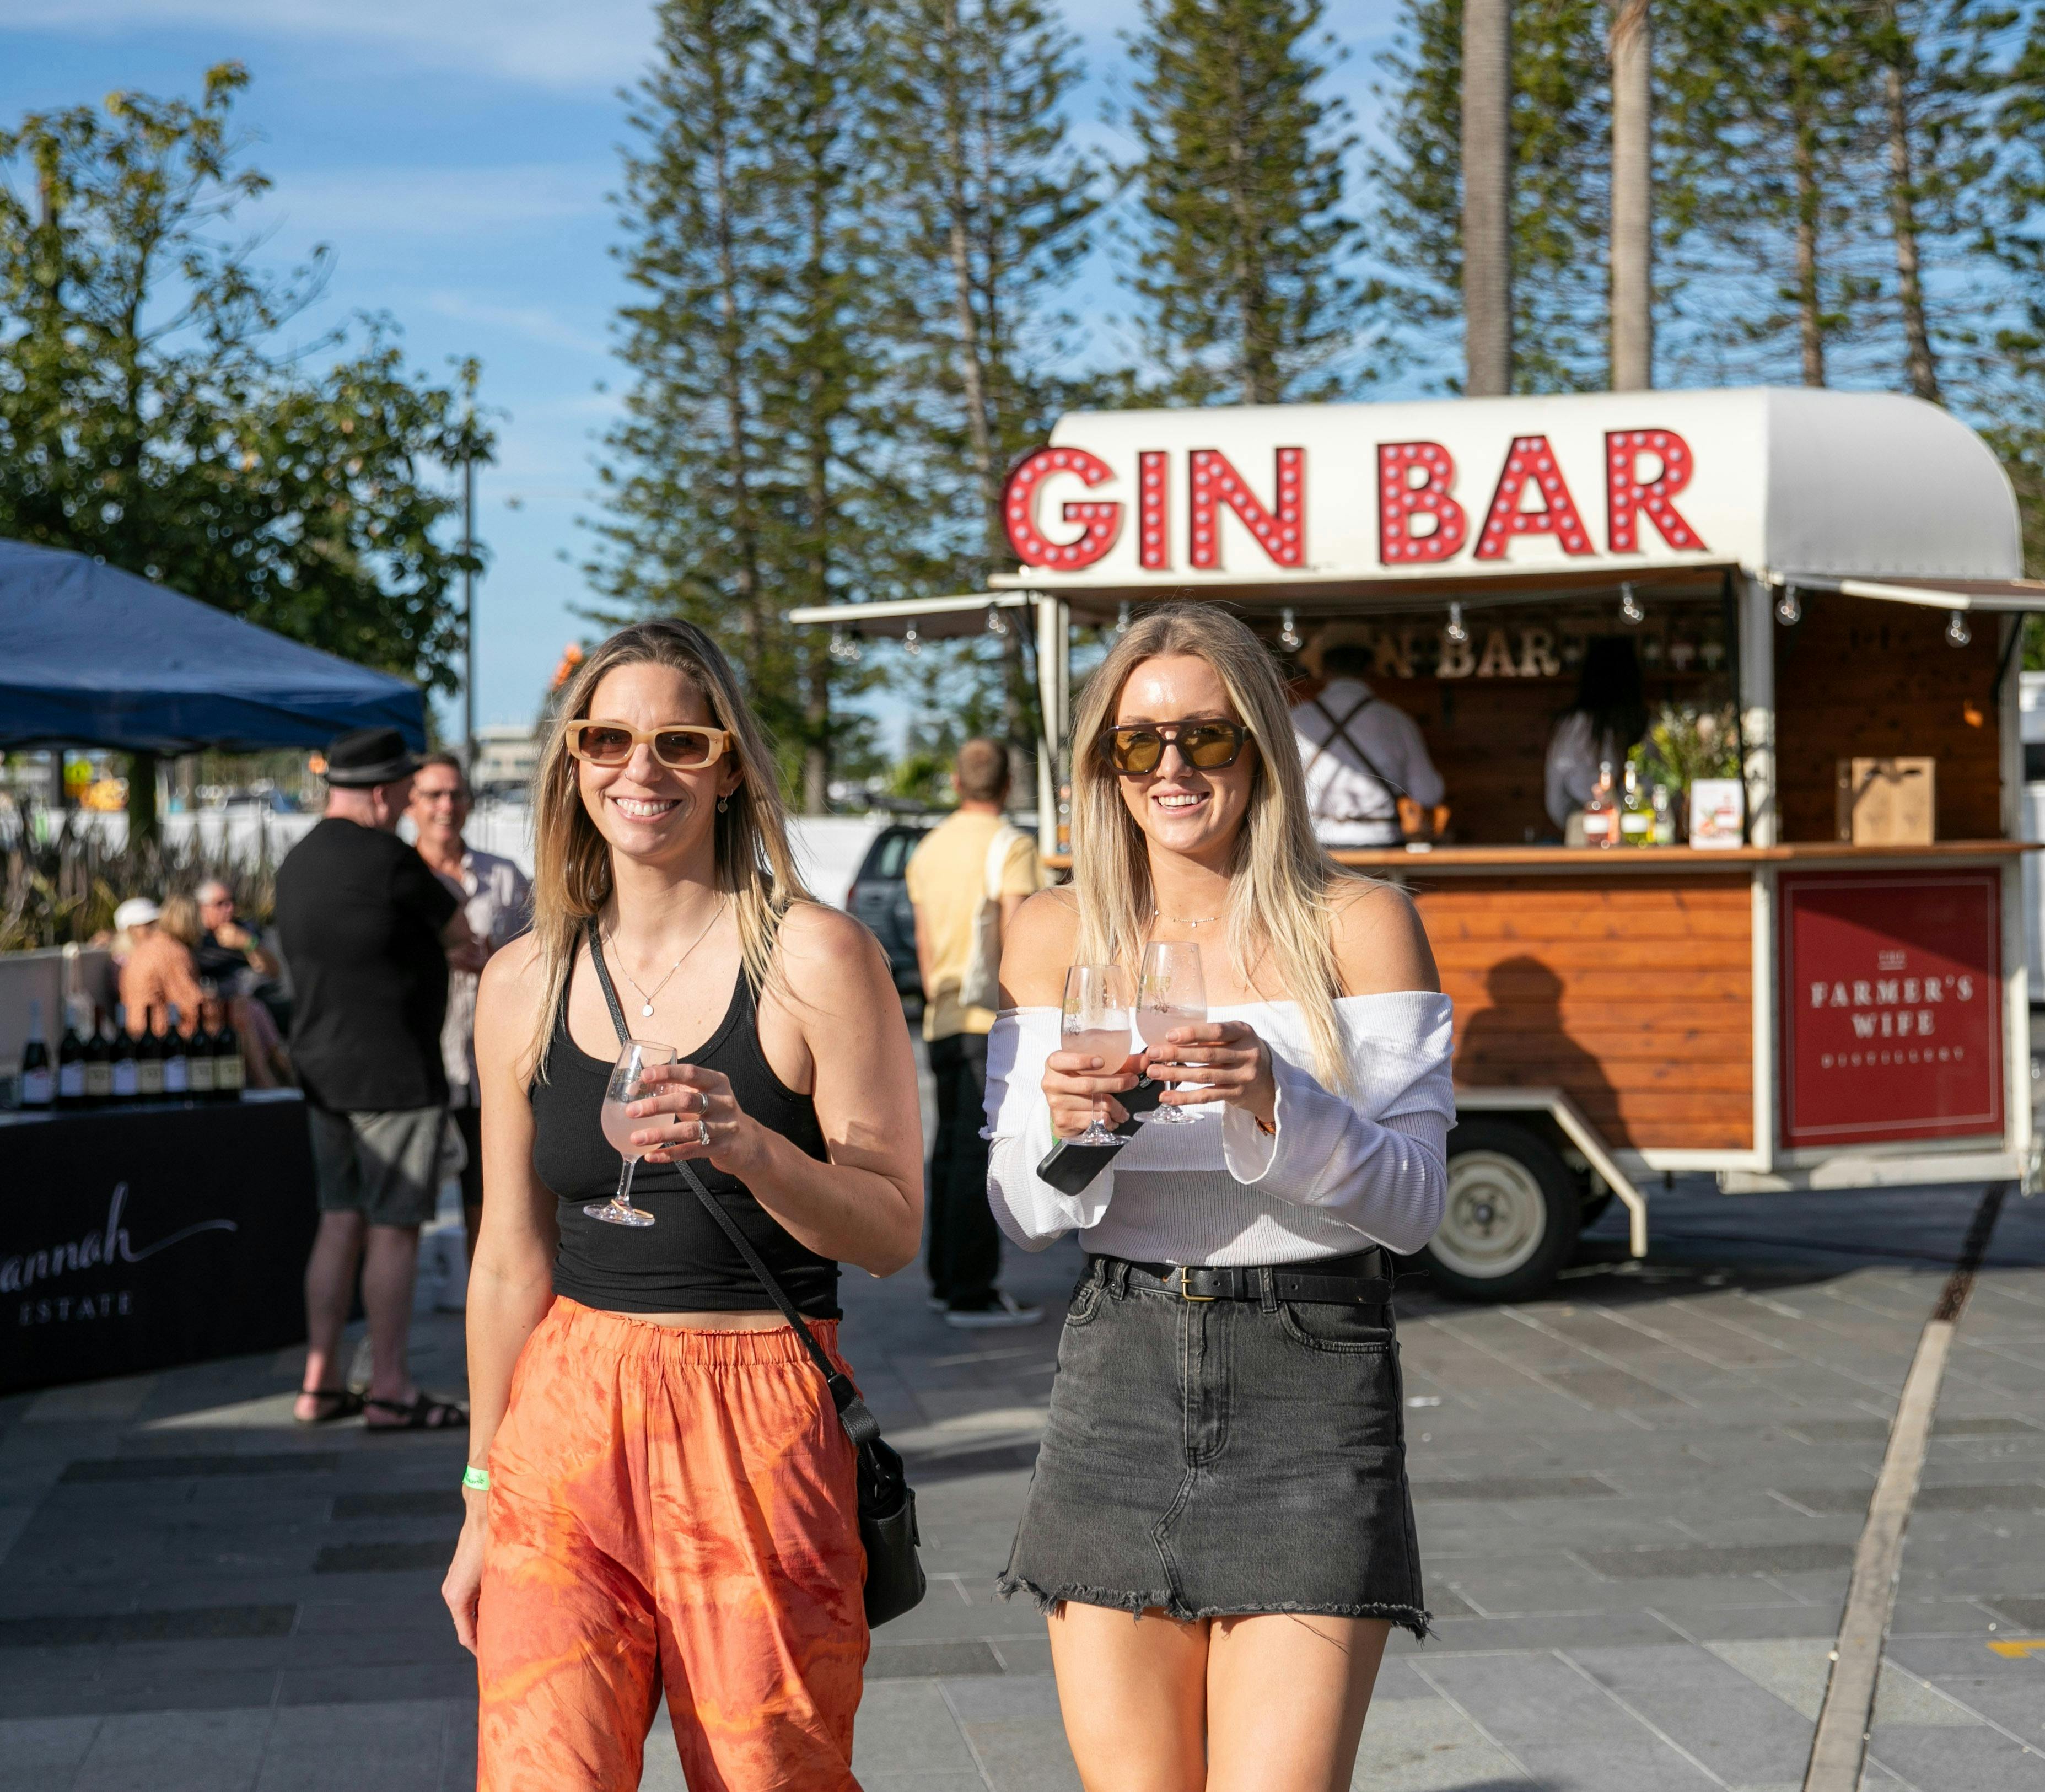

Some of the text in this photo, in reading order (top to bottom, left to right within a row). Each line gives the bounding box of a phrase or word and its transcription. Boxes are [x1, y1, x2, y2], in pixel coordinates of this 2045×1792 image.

[1002, 429, 1710, 572] GIN BAR
[1435, 627, 1561, 679] BAR
[1810, 975, 1973, 1008] FARMER'S
[1850, 1009, 1935, 1038] WIFE
[20, 1290, 132, 1326] ESTATE
